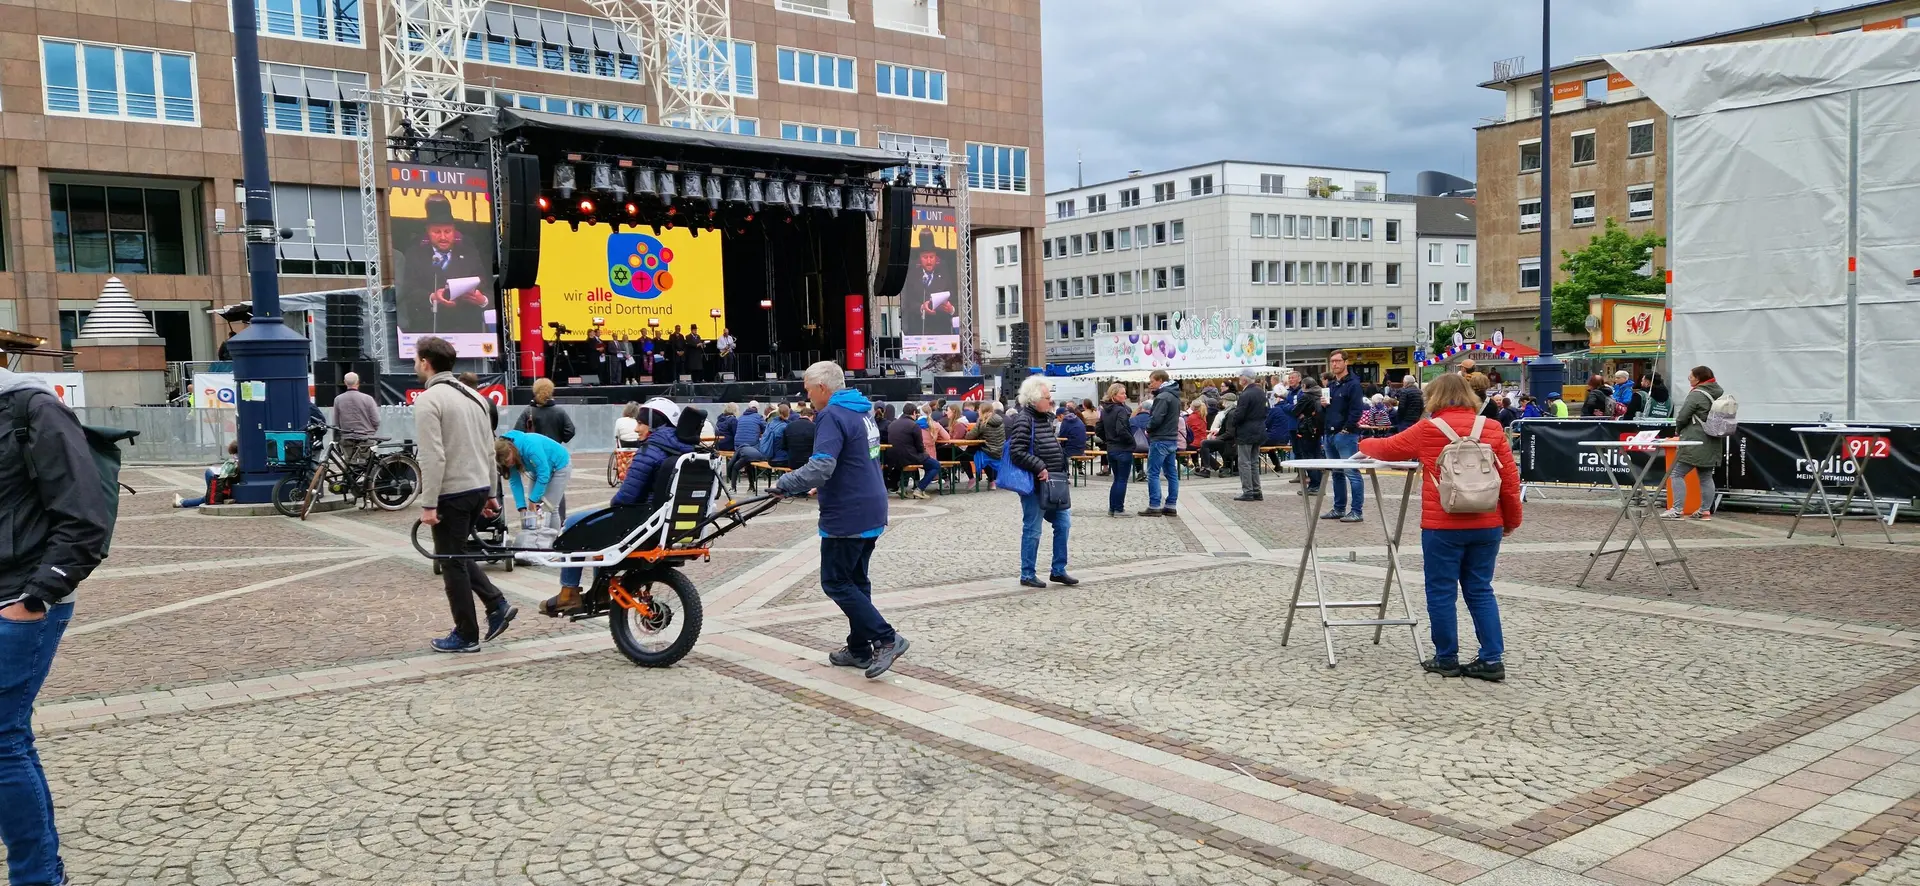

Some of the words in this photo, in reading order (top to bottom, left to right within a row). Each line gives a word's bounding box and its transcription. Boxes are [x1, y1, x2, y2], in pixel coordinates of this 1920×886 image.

[564, 290, 583, 302] wir
[587, 287, 613, 302] alle
[588, 303, 612, 315] sind
[616, 303, 673, 315] Dortmund
[1850, 440, 1886, 457] 91.2
[1796, 455, 1857, 474] radio
